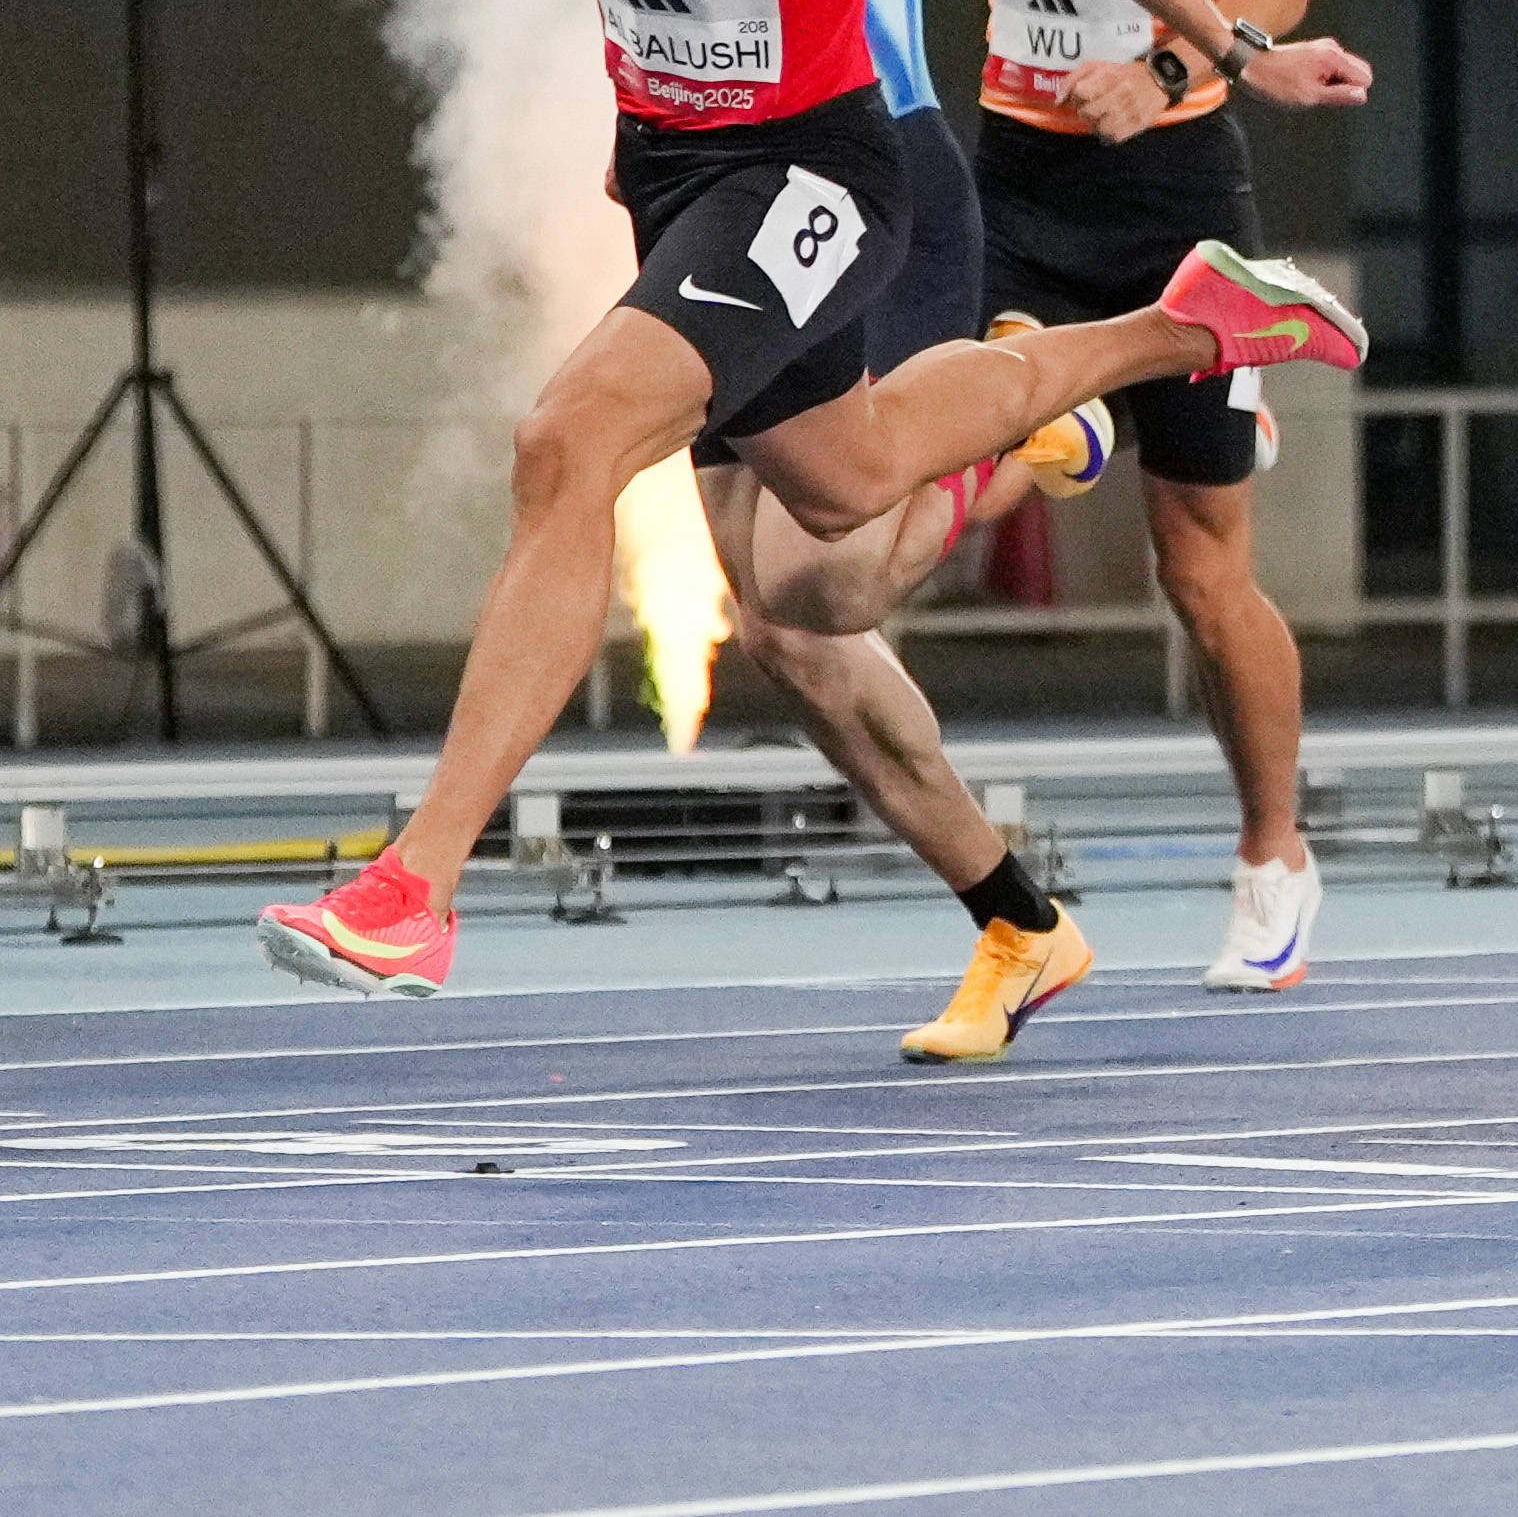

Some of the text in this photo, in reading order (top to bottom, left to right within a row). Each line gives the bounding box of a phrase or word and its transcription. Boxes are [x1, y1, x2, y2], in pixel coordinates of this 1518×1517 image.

[738, 20, 769, 34] 208
[1027, 24, 1081, 60] WU
[629, 28, 769, 70] BALUSHI
[647, 78, 754, 111] Beijing2025
[793, 204, 839, 268] 8
